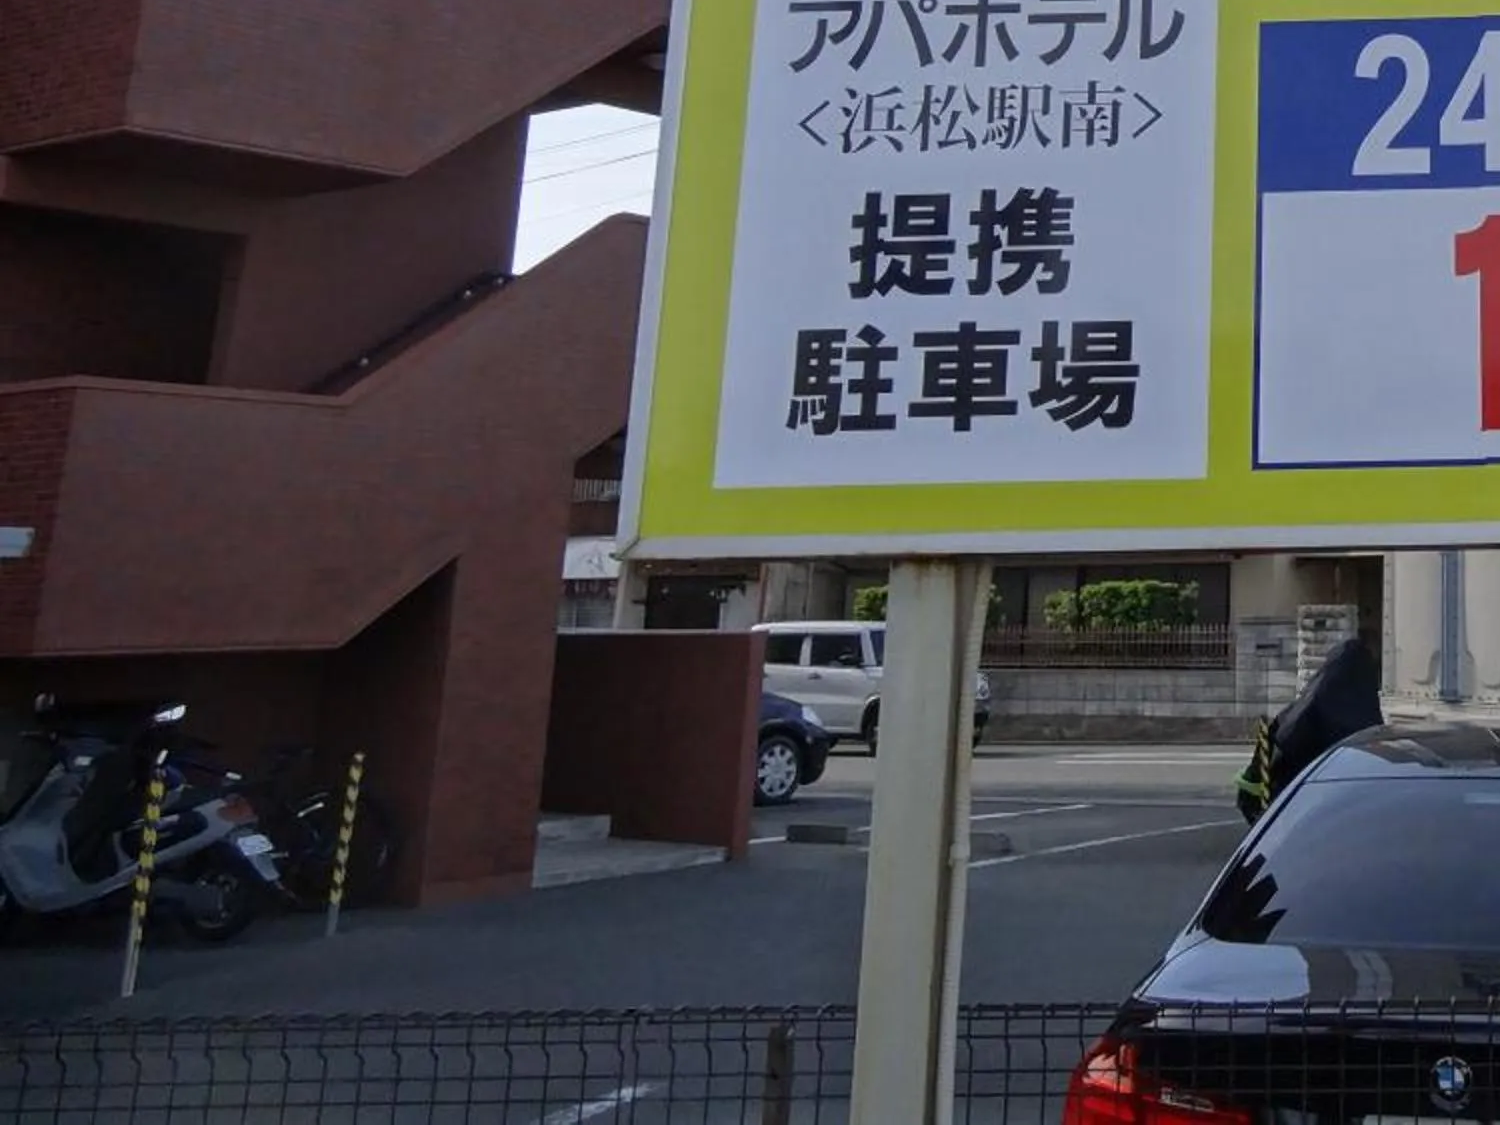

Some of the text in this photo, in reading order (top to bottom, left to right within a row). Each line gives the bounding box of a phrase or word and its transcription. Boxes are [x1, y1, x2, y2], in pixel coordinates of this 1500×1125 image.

[847, 185, 1077, 300] 提携
[785, 319, 1141, 437] 駐車場
